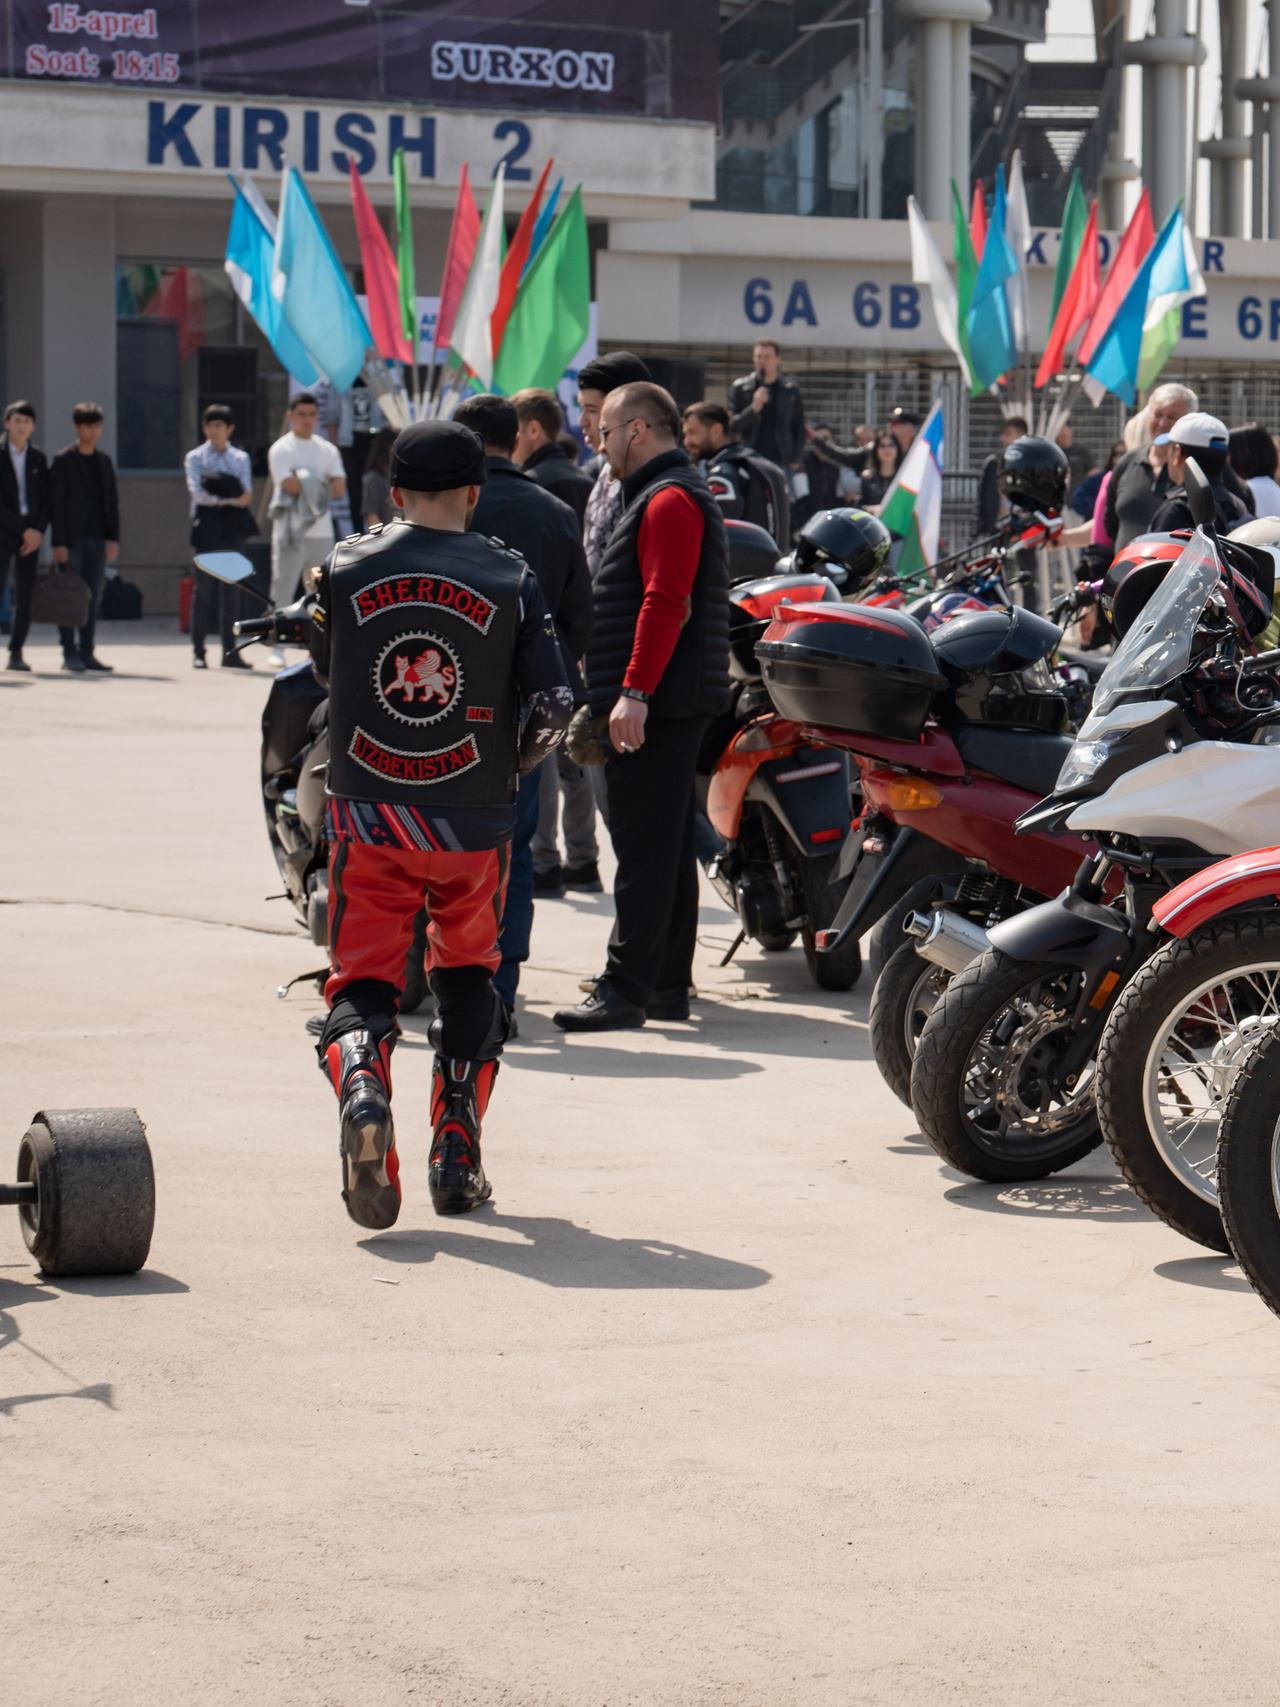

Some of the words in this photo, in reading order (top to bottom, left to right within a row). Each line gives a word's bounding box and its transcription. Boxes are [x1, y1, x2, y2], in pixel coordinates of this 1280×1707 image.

[49, 4, 157, 39] 15-aprel
[27, 45, 99, 77] Soat:
[112, 51, 179, 81] 18:15
[432, 41, 613, 91] SURXON
[147, 101, 436, 178] KIRISH
[493, 119, 532, 181] 2
[743, 278, 818, 326] 6A
[853, 282, 921, 328] 6B
[358, 579, 490, 626] SHERDOR
[467, 707, 492, 721] MCS
[354, 735, 477, 780] UZBEKISTAN
